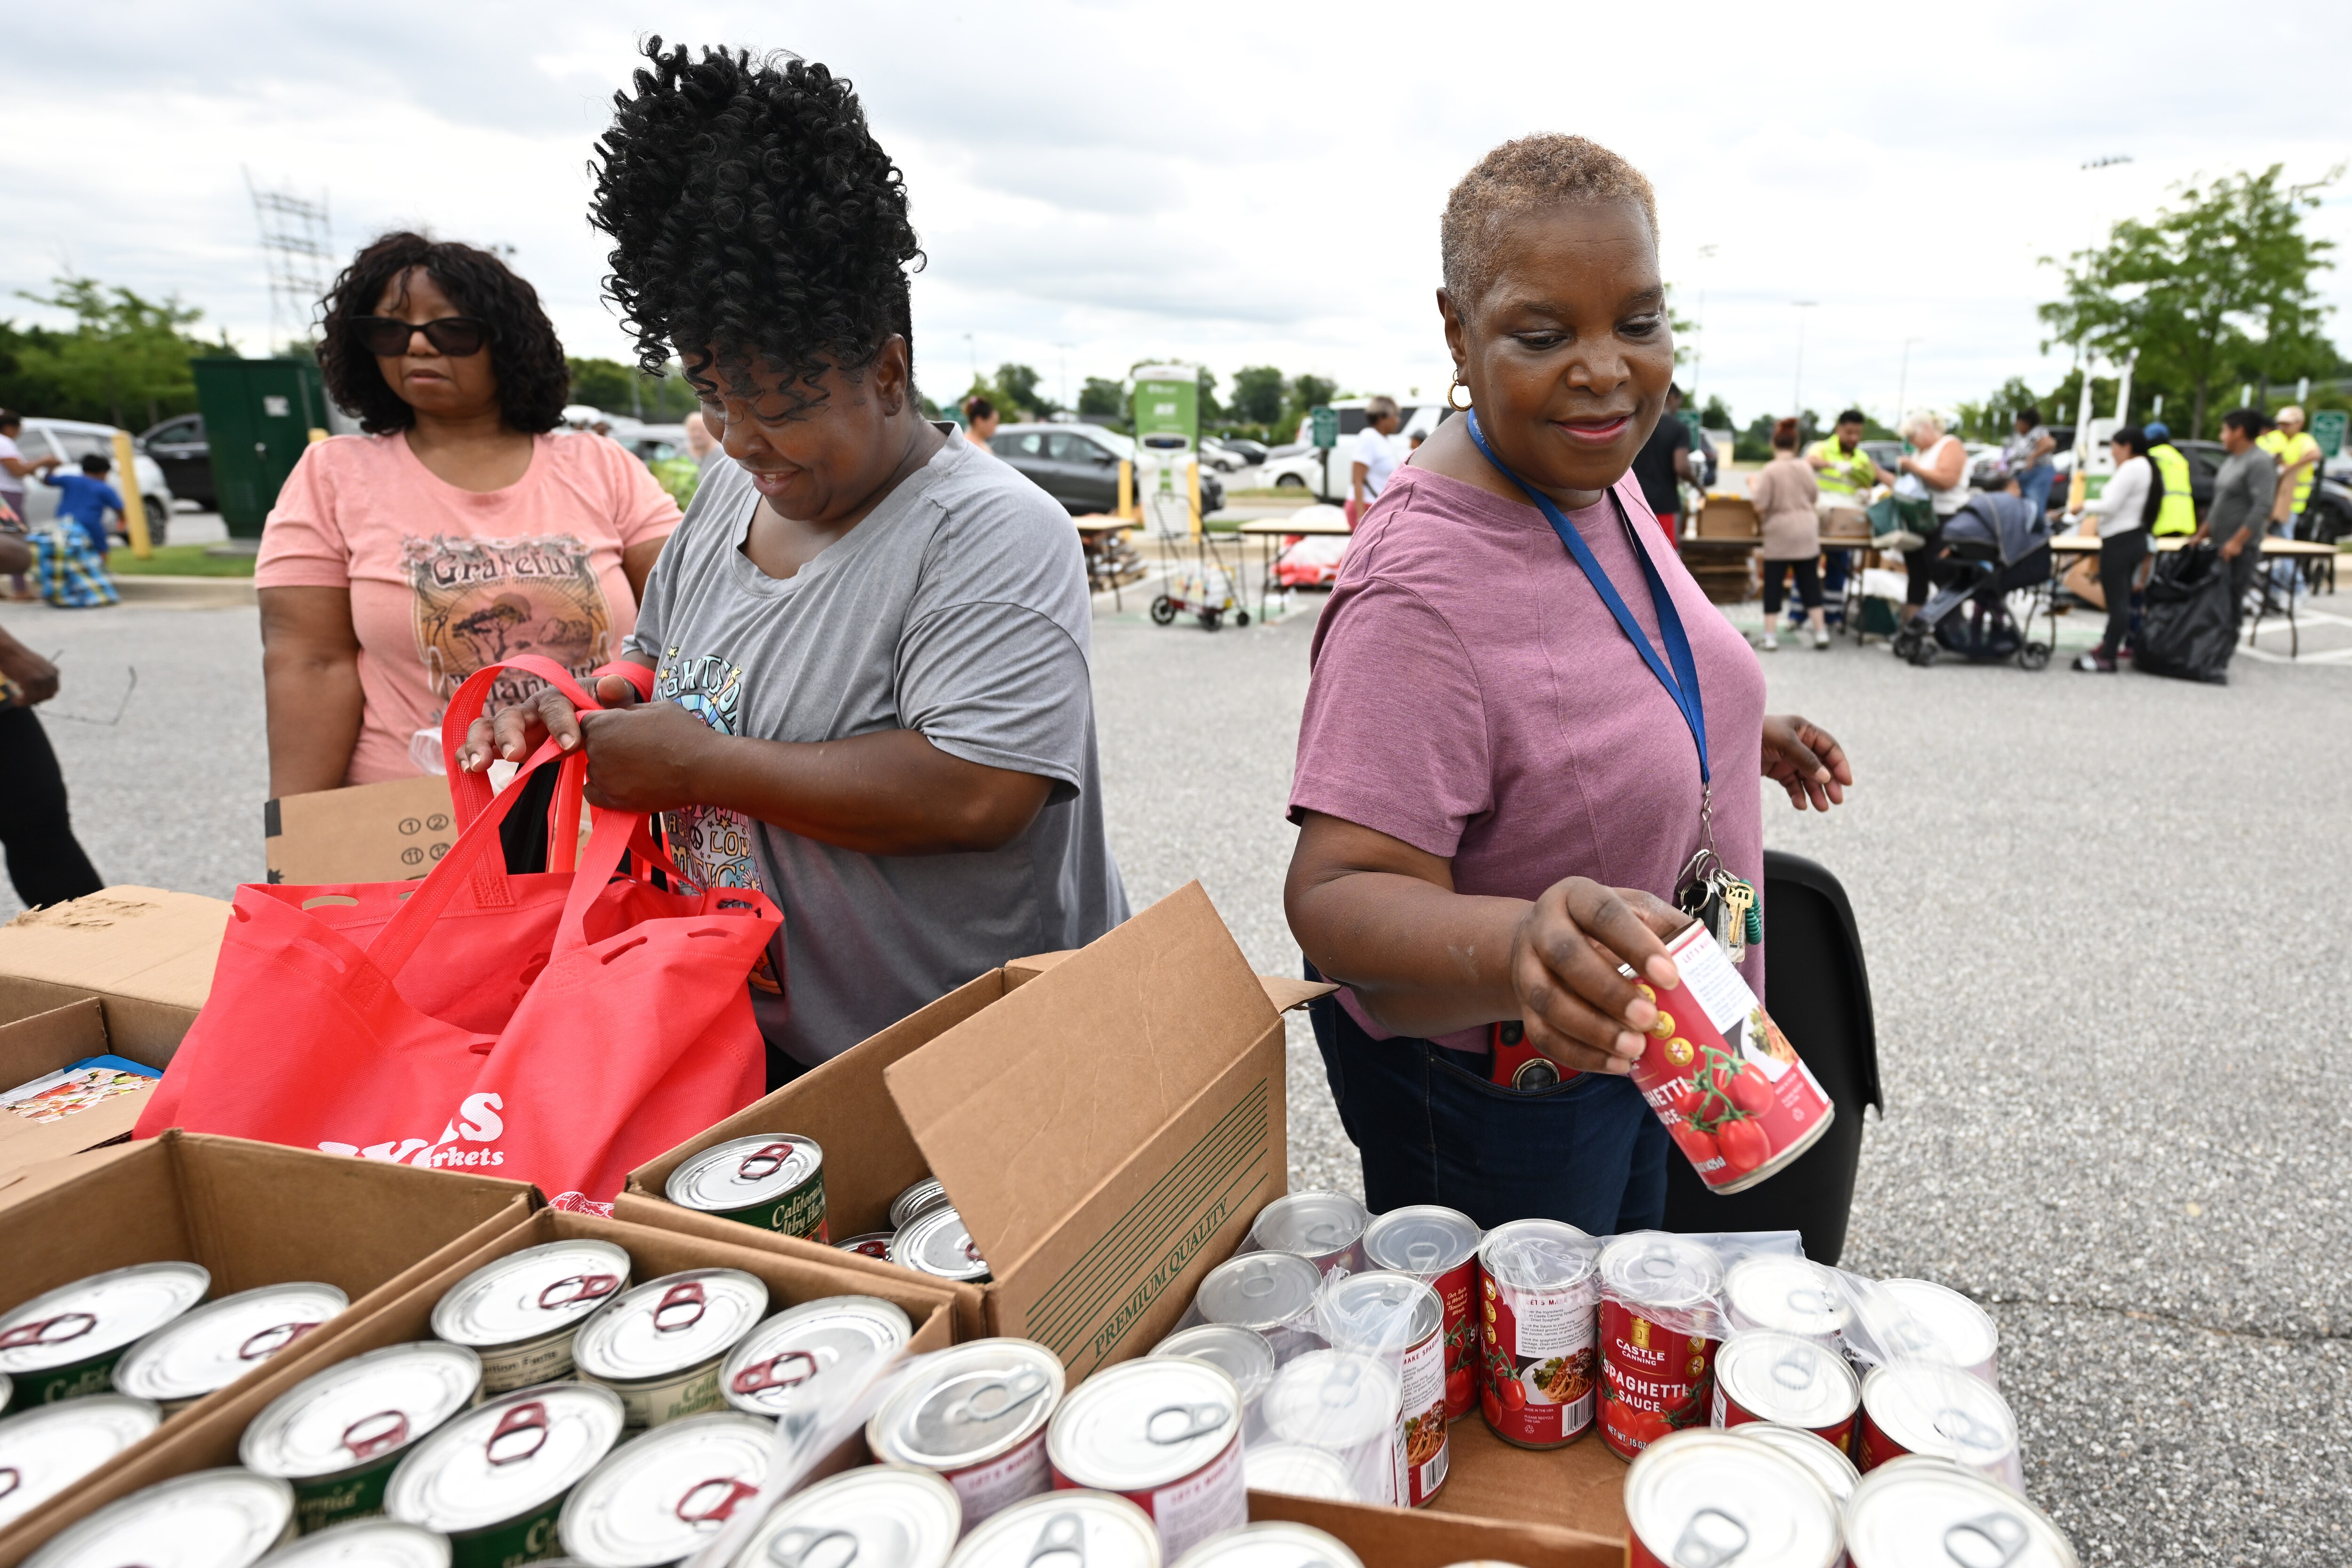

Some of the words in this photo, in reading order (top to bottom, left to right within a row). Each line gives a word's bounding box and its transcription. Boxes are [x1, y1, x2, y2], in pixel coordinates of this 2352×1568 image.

[432, 548, 579, 588] Grateful
[432, 1146, 504, 1167] rkets
[1095, 1263, 1167, 1359] PREMIUM
[1169, 1197, 1227, 1277] QUALITY
[1447, 1297, 1468, 1312] Thousand
[1452, 1306, 1465, 1316] Words
[1616, 1338, 1665, 1361] CASTLE
[1621, 1350, 1657, 1366] CANNING
[1603, 1358, 1687, 1399] SPAGHETTI
[1618, 1389, 1661, 1413] SAUCE
[1607, 1423, 1617, 1437] NET
[1617, 1433, 1628, 1444] WT.
[1629, 1437, 1637, 1448] 15
[1637, 1440, 1647, 1451] OZ
